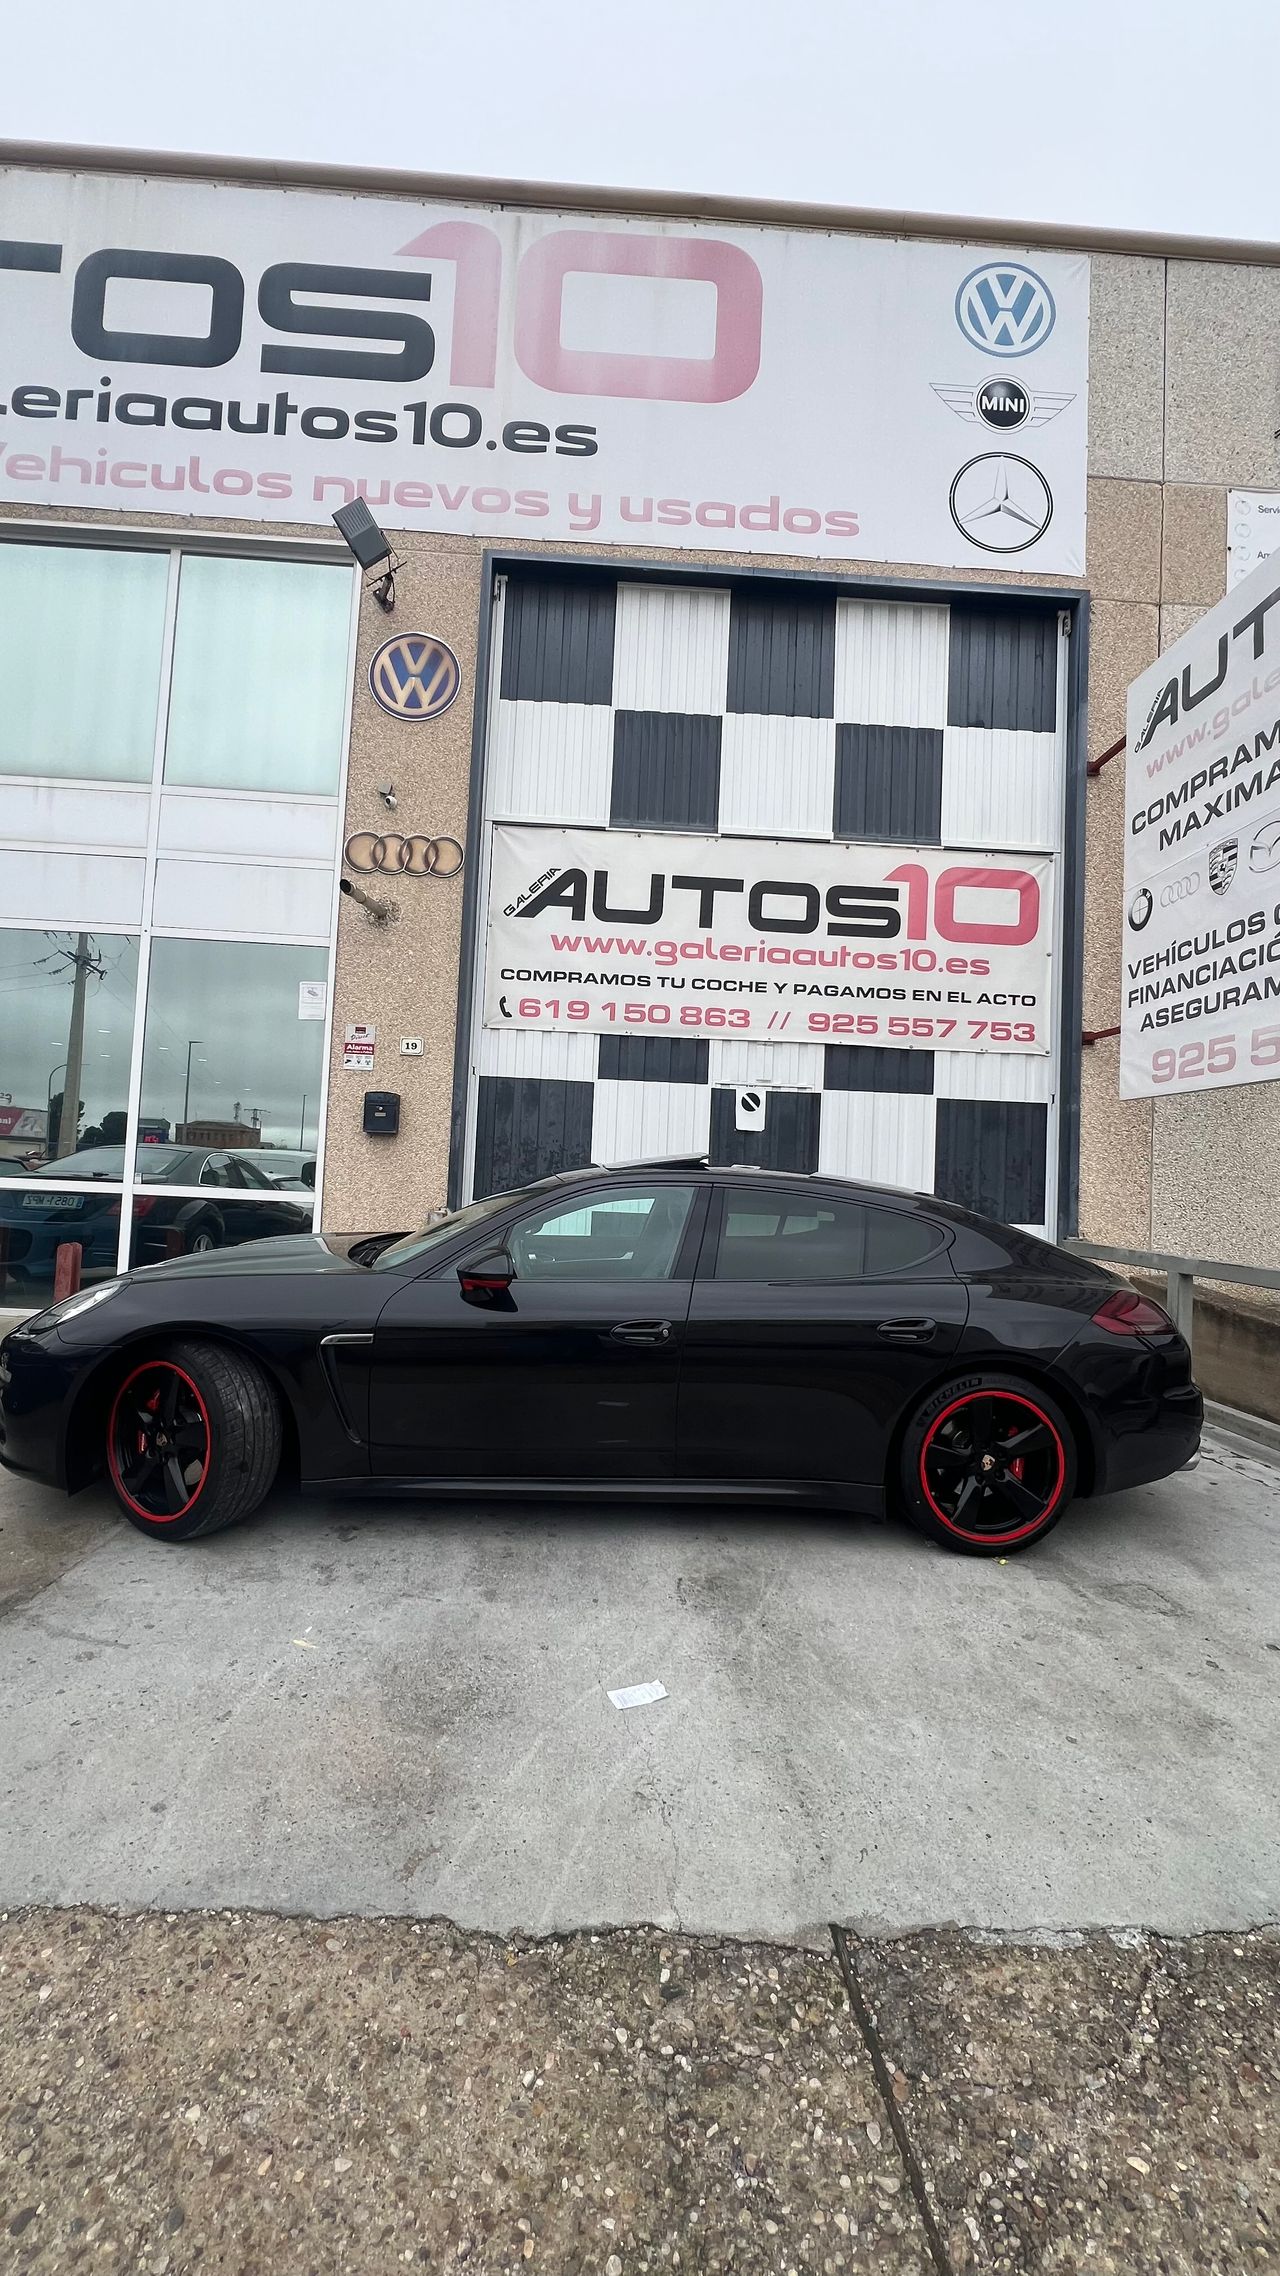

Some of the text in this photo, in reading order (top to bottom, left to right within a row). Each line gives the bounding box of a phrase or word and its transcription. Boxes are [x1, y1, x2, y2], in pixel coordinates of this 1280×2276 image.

[0, 376, 600, 457] eriaautos10.es
[981, 394, 1026, 414] MINI
[0, 441, 860, 537] ehiculos nuevos y usados
[1134, 686, 1165, 753] GALERIA
[503, 867, 562, 917] GALERIA
[513, 863, 1041, 946] AUTOS10
[550, 934, 991, 976] www.galeriaautos10.es
[1128, 911, 1266, 979] VEHÍCULOS
[500, 968, 1037, 1007] COMPRAMOS TU COCHE Y PAGAMOS EN EL ACTO
[518, 998, 590, 1019] 619
[601, 1002, 671, 1024] 150
[679, 1006, 751, 1029] 863
[808, 1012, 879, 1035] 925
[888, 1016, 957, 1038] 557
[967, 1020, 1036, 1043] 753
[405, 1042, 417, 1050] 19
[1151, 1034, 1237, 1084] 925
